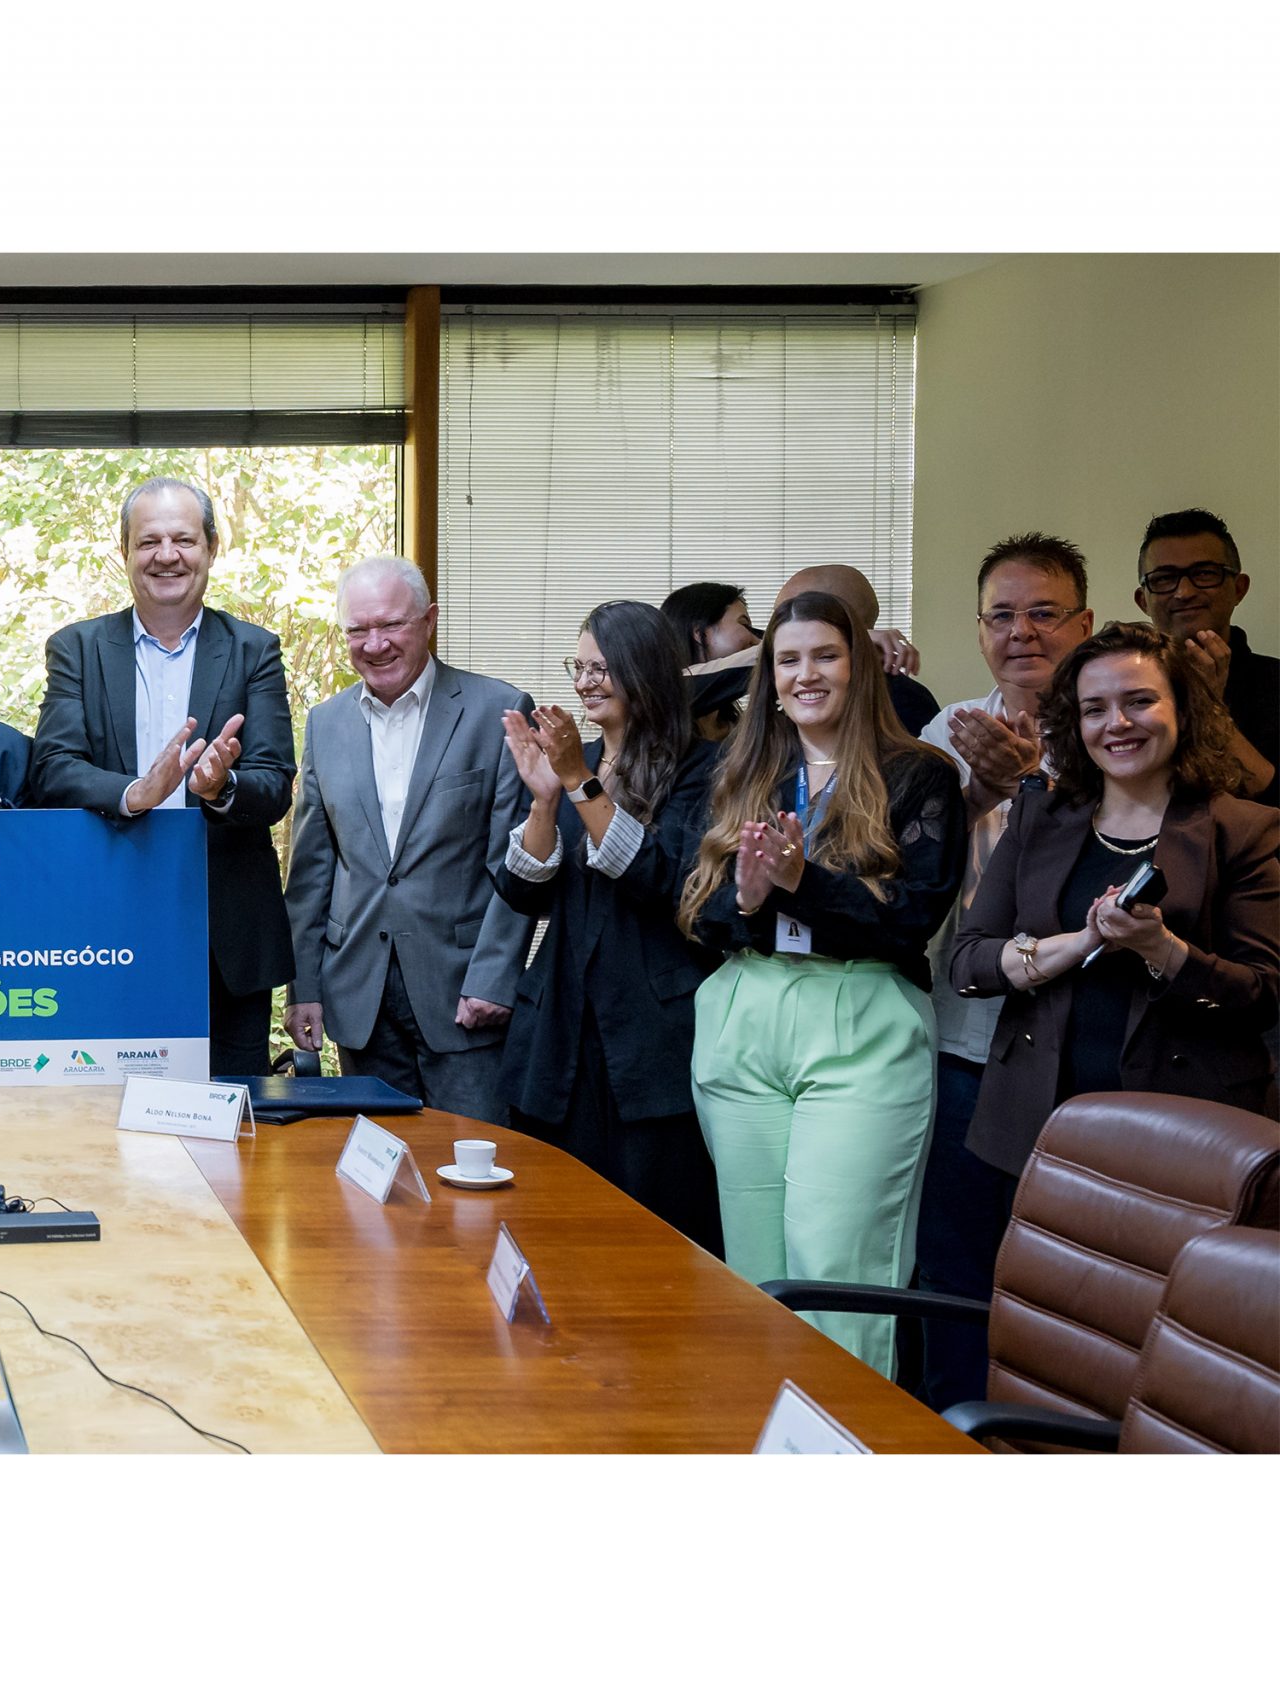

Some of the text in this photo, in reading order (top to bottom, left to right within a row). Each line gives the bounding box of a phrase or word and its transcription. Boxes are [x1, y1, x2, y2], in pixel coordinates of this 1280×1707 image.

[116, 1049, 159, 1059] PARANÁ
[0, 1058, 32, 1068] BRDE
[208, 1092, 228, 1101] BRDE
[145, 1107, 213, 1122] ALDO NELSON BONA
